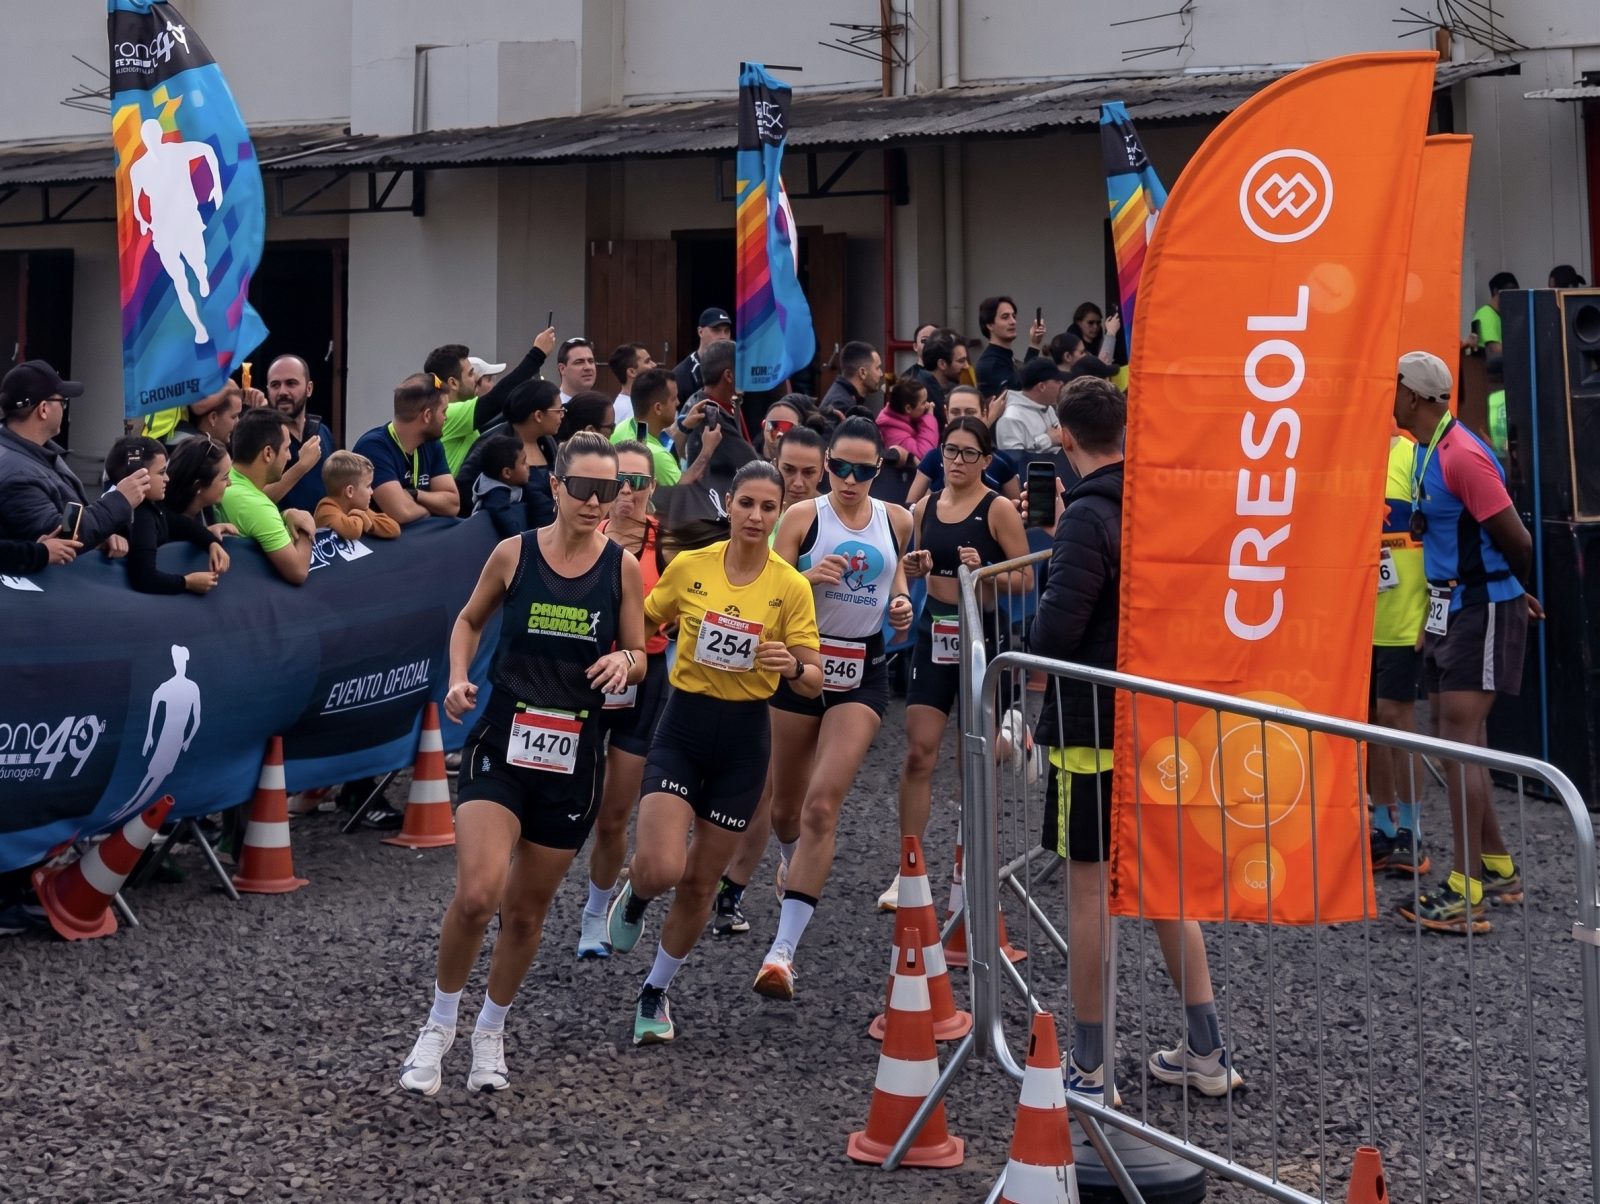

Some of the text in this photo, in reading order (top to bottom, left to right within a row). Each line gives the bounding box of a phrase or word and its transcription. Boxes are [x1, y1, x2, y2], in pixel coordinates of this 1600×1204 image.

[1223, 284, 1310, 641] CRESOL
[706, 630, 752, 659] 254
[823, 659, 857, 679] 546
[324, 658, 430, 709] EVENTO OFICIAL
[521, 730, 572, 756] 1470
[709, 810, 746, 828] MIMO
